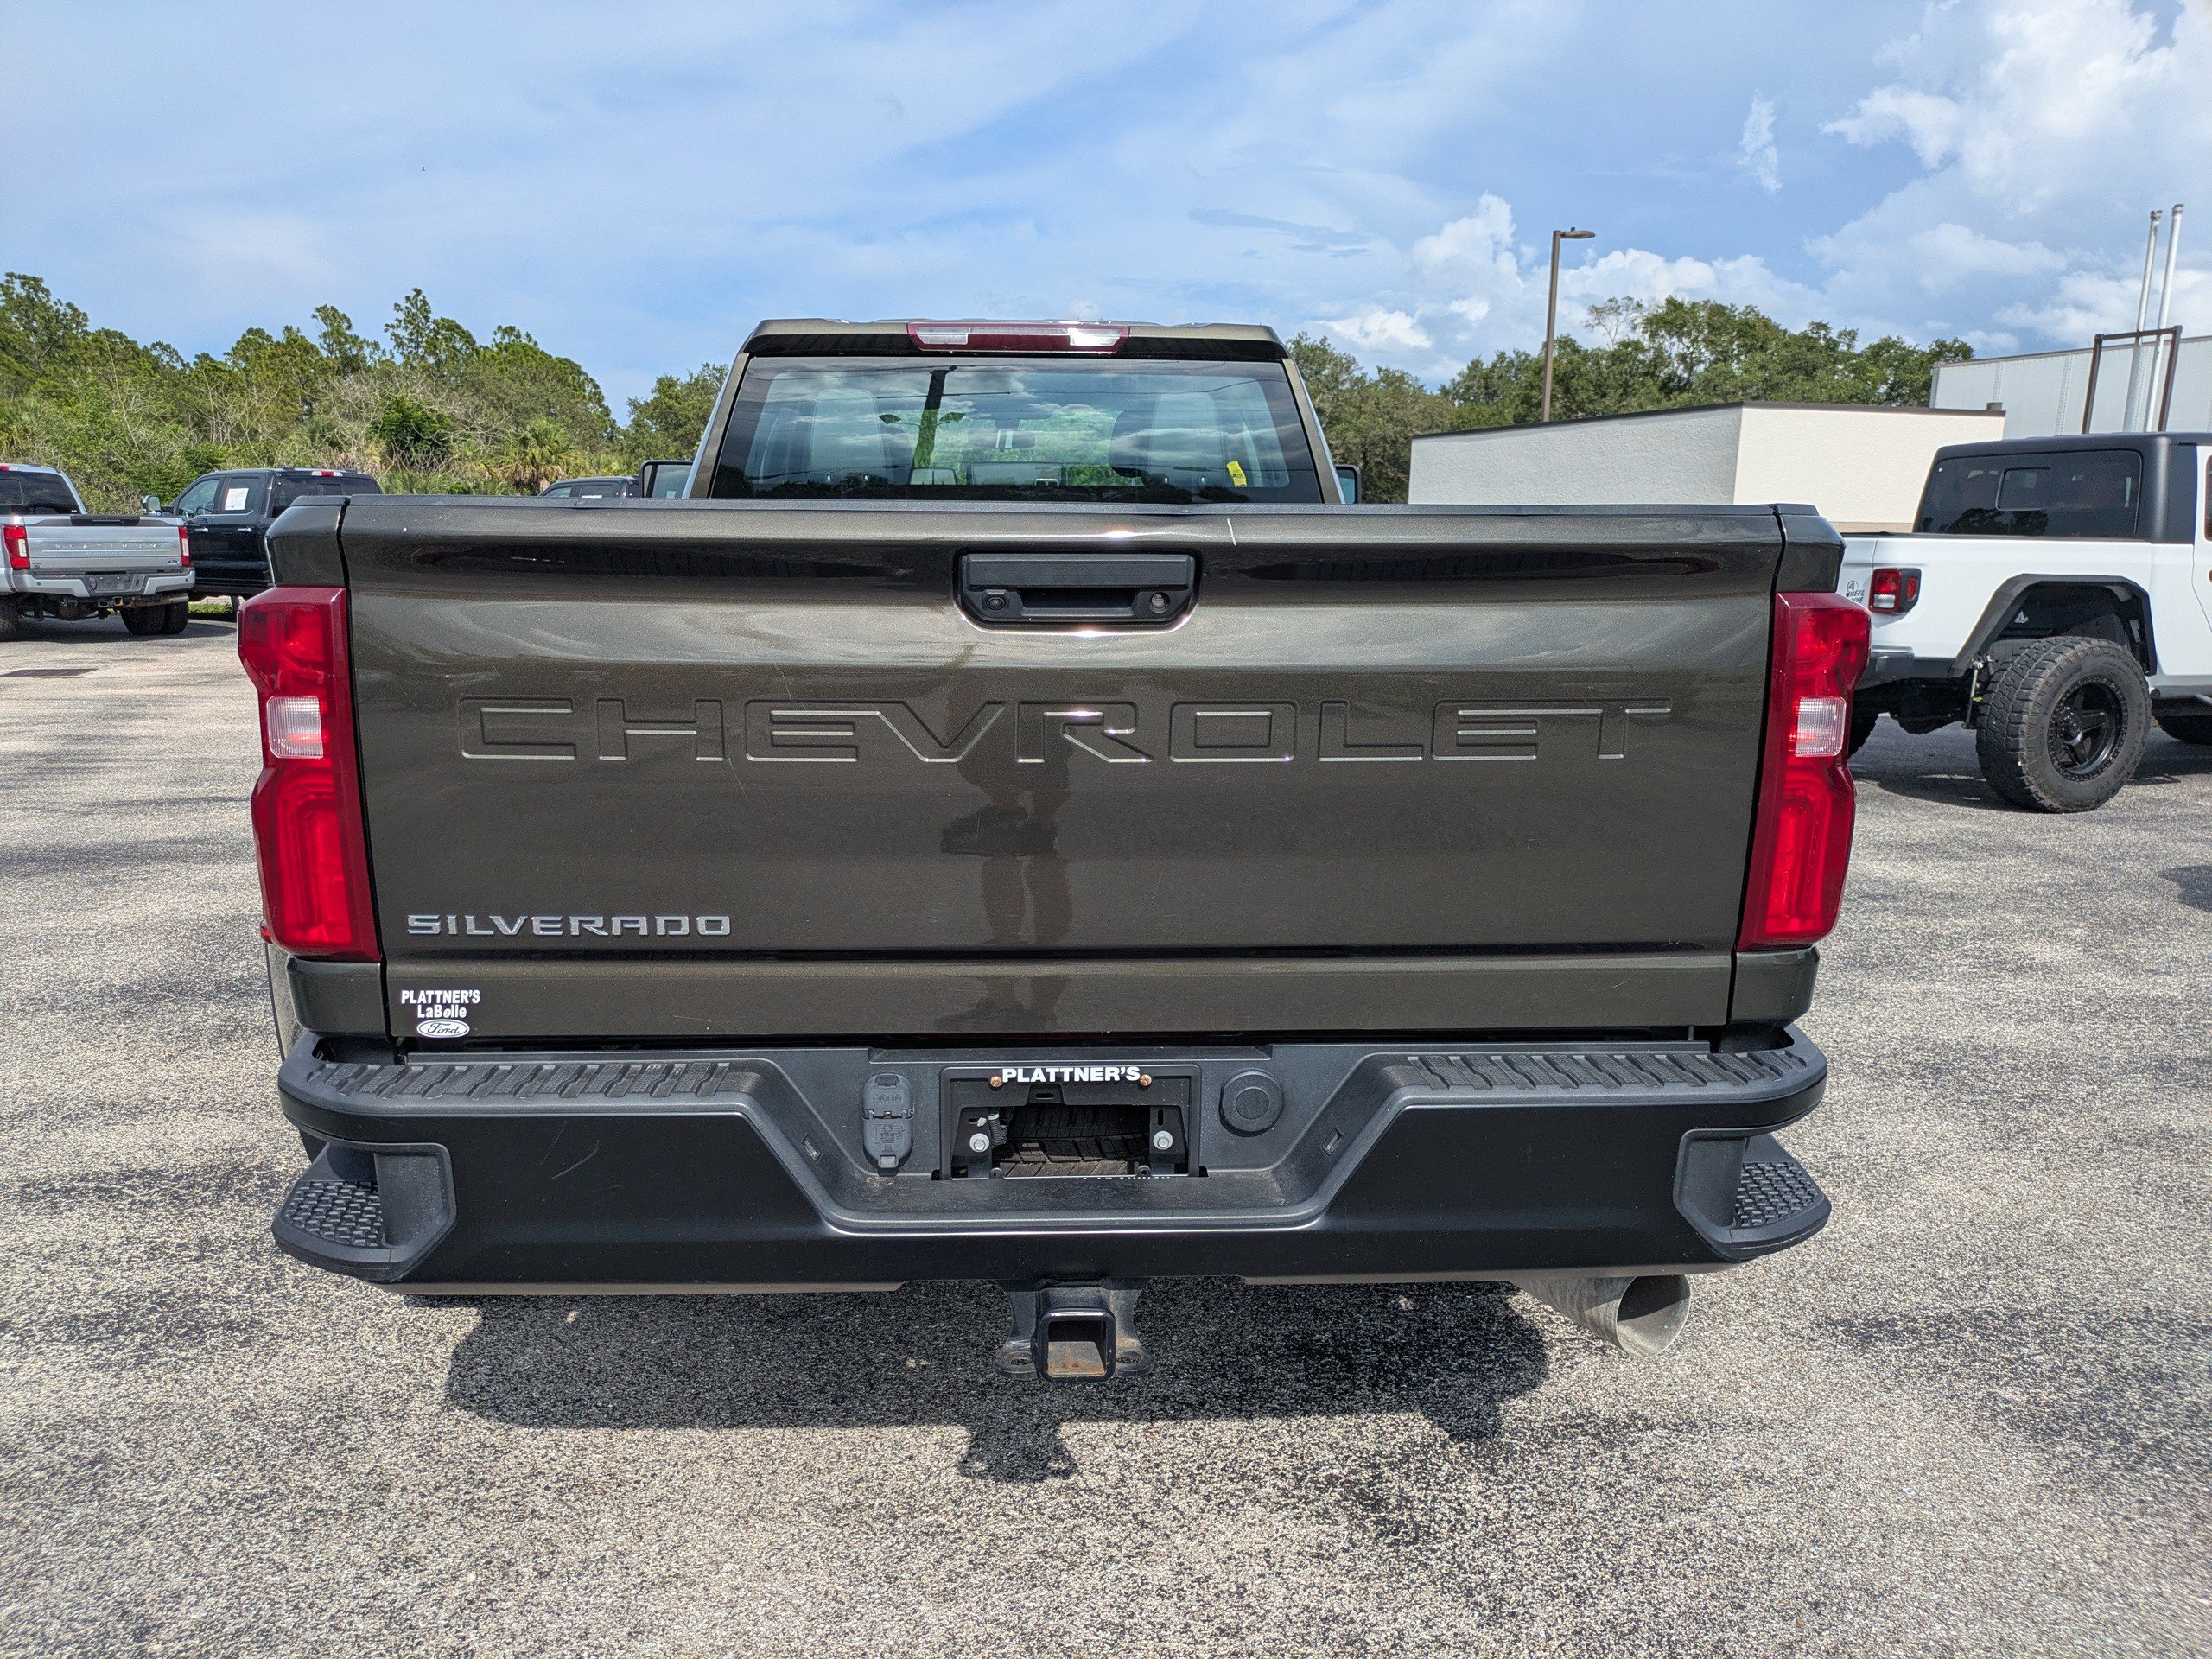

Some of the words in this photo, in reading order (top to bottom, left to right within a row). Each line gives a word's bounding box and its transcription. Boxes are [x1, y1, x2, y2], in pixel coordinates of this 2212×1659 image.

[458, 696, 1672, 763] CHEVROLET
[407, 914, 732, 936] SILVERADO
[401, 989, 481, 1004] PLATTNER'S
[416, 1004, 467, 1018] LaBelle
[427, 1022, 461, 1034] Ford
[1001, 1066, 1141, 1083] PLATTNER'S
